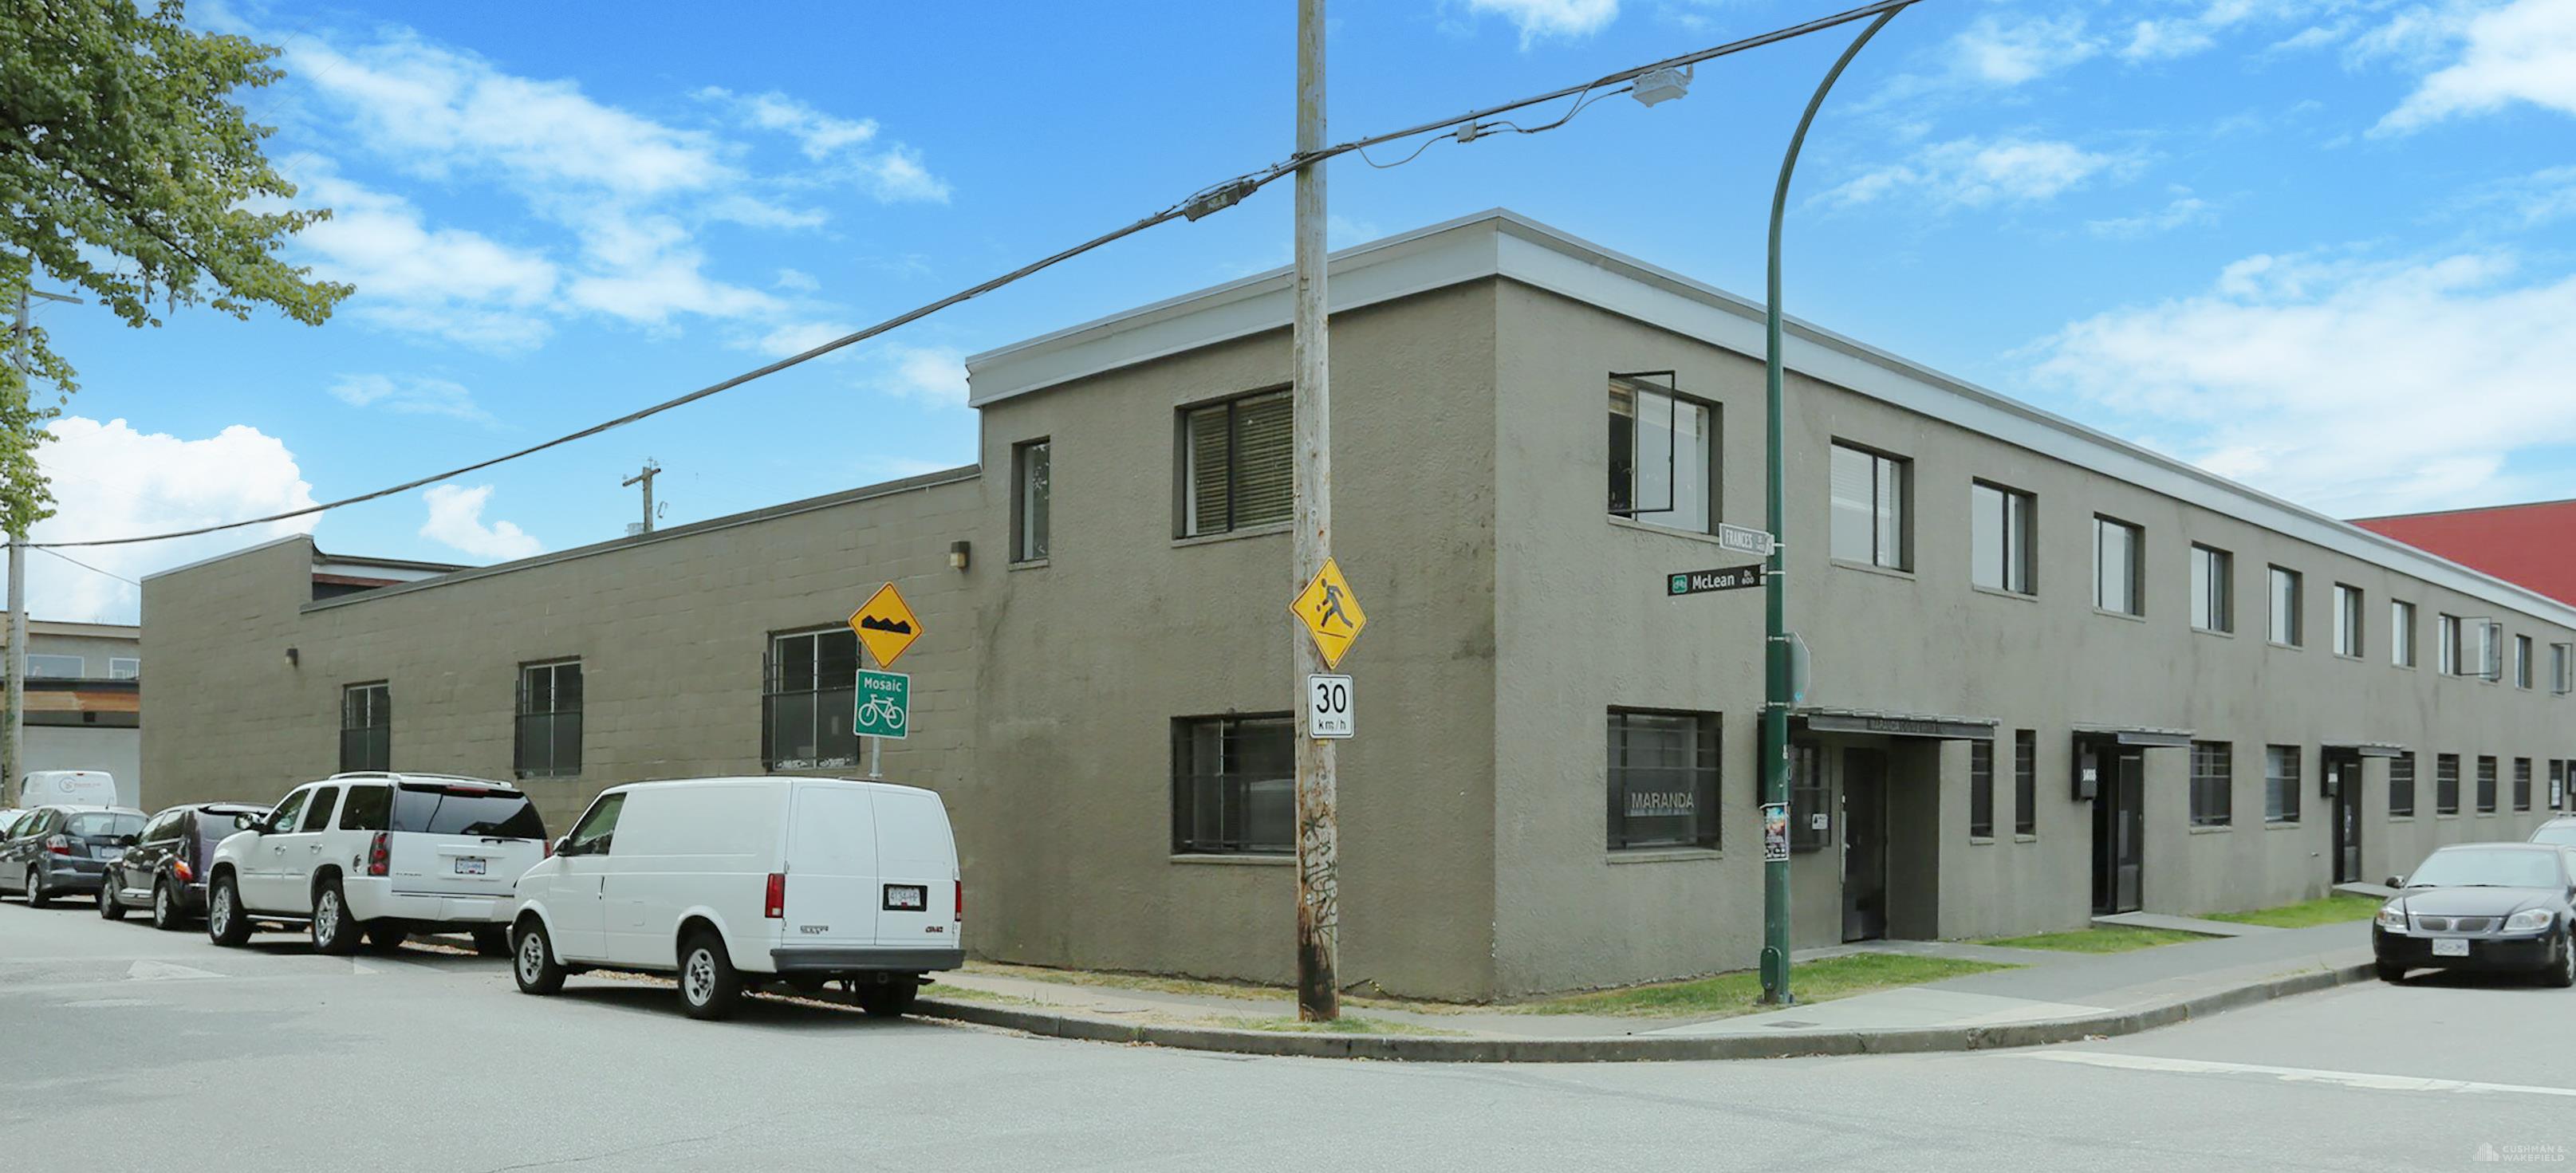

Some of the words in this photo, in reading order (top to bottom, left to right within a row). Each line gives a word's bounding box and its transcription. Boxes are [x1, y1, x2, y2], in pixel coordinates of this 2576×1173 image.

[1725, 529, 1753, 549] FRANCES
[1692, 573, 1735, 590] McLean
[864, 677, 903, 692] Mosaic
[1316, 683, 1346, 714] 30
[1318, 718, 1347, 730] km/h
[1631, 792, 1695, 809] MARANDA
